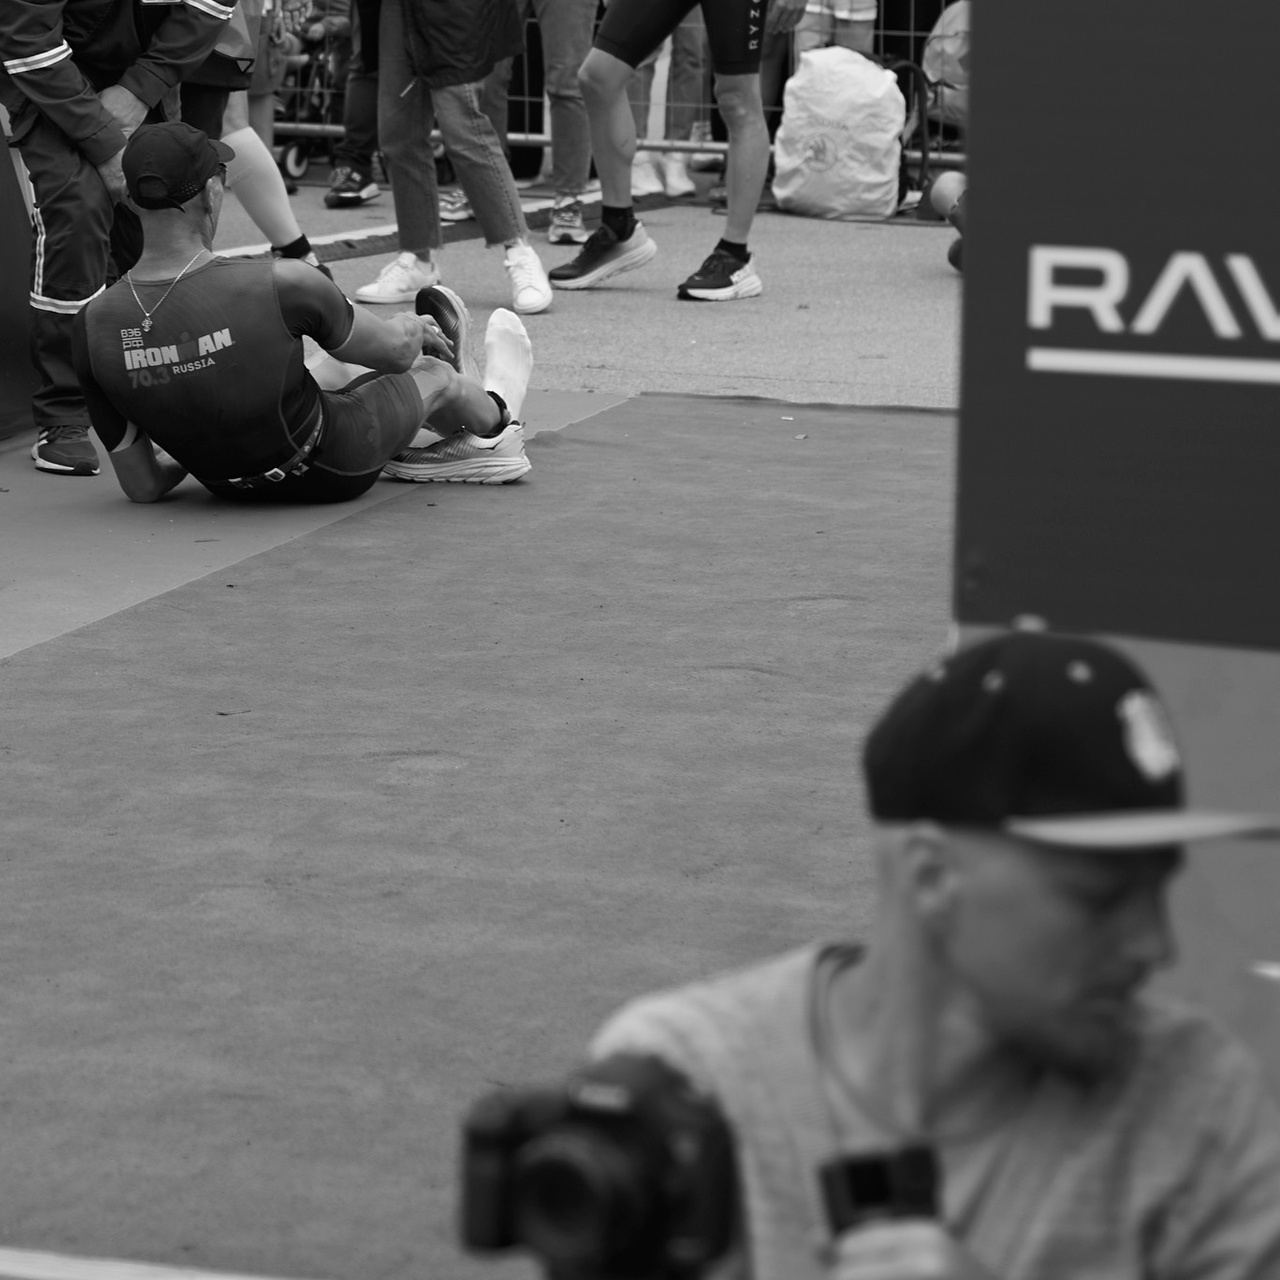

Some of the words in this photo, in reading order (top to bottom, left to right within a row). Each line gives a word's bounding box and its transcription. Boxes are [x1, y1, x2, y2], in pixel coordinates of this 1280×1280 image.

[120, 328, 142, 338] ВЭБ
[128, 366, 172, 389] 70.3
[172, 357, 216, 375] RUSSIA
